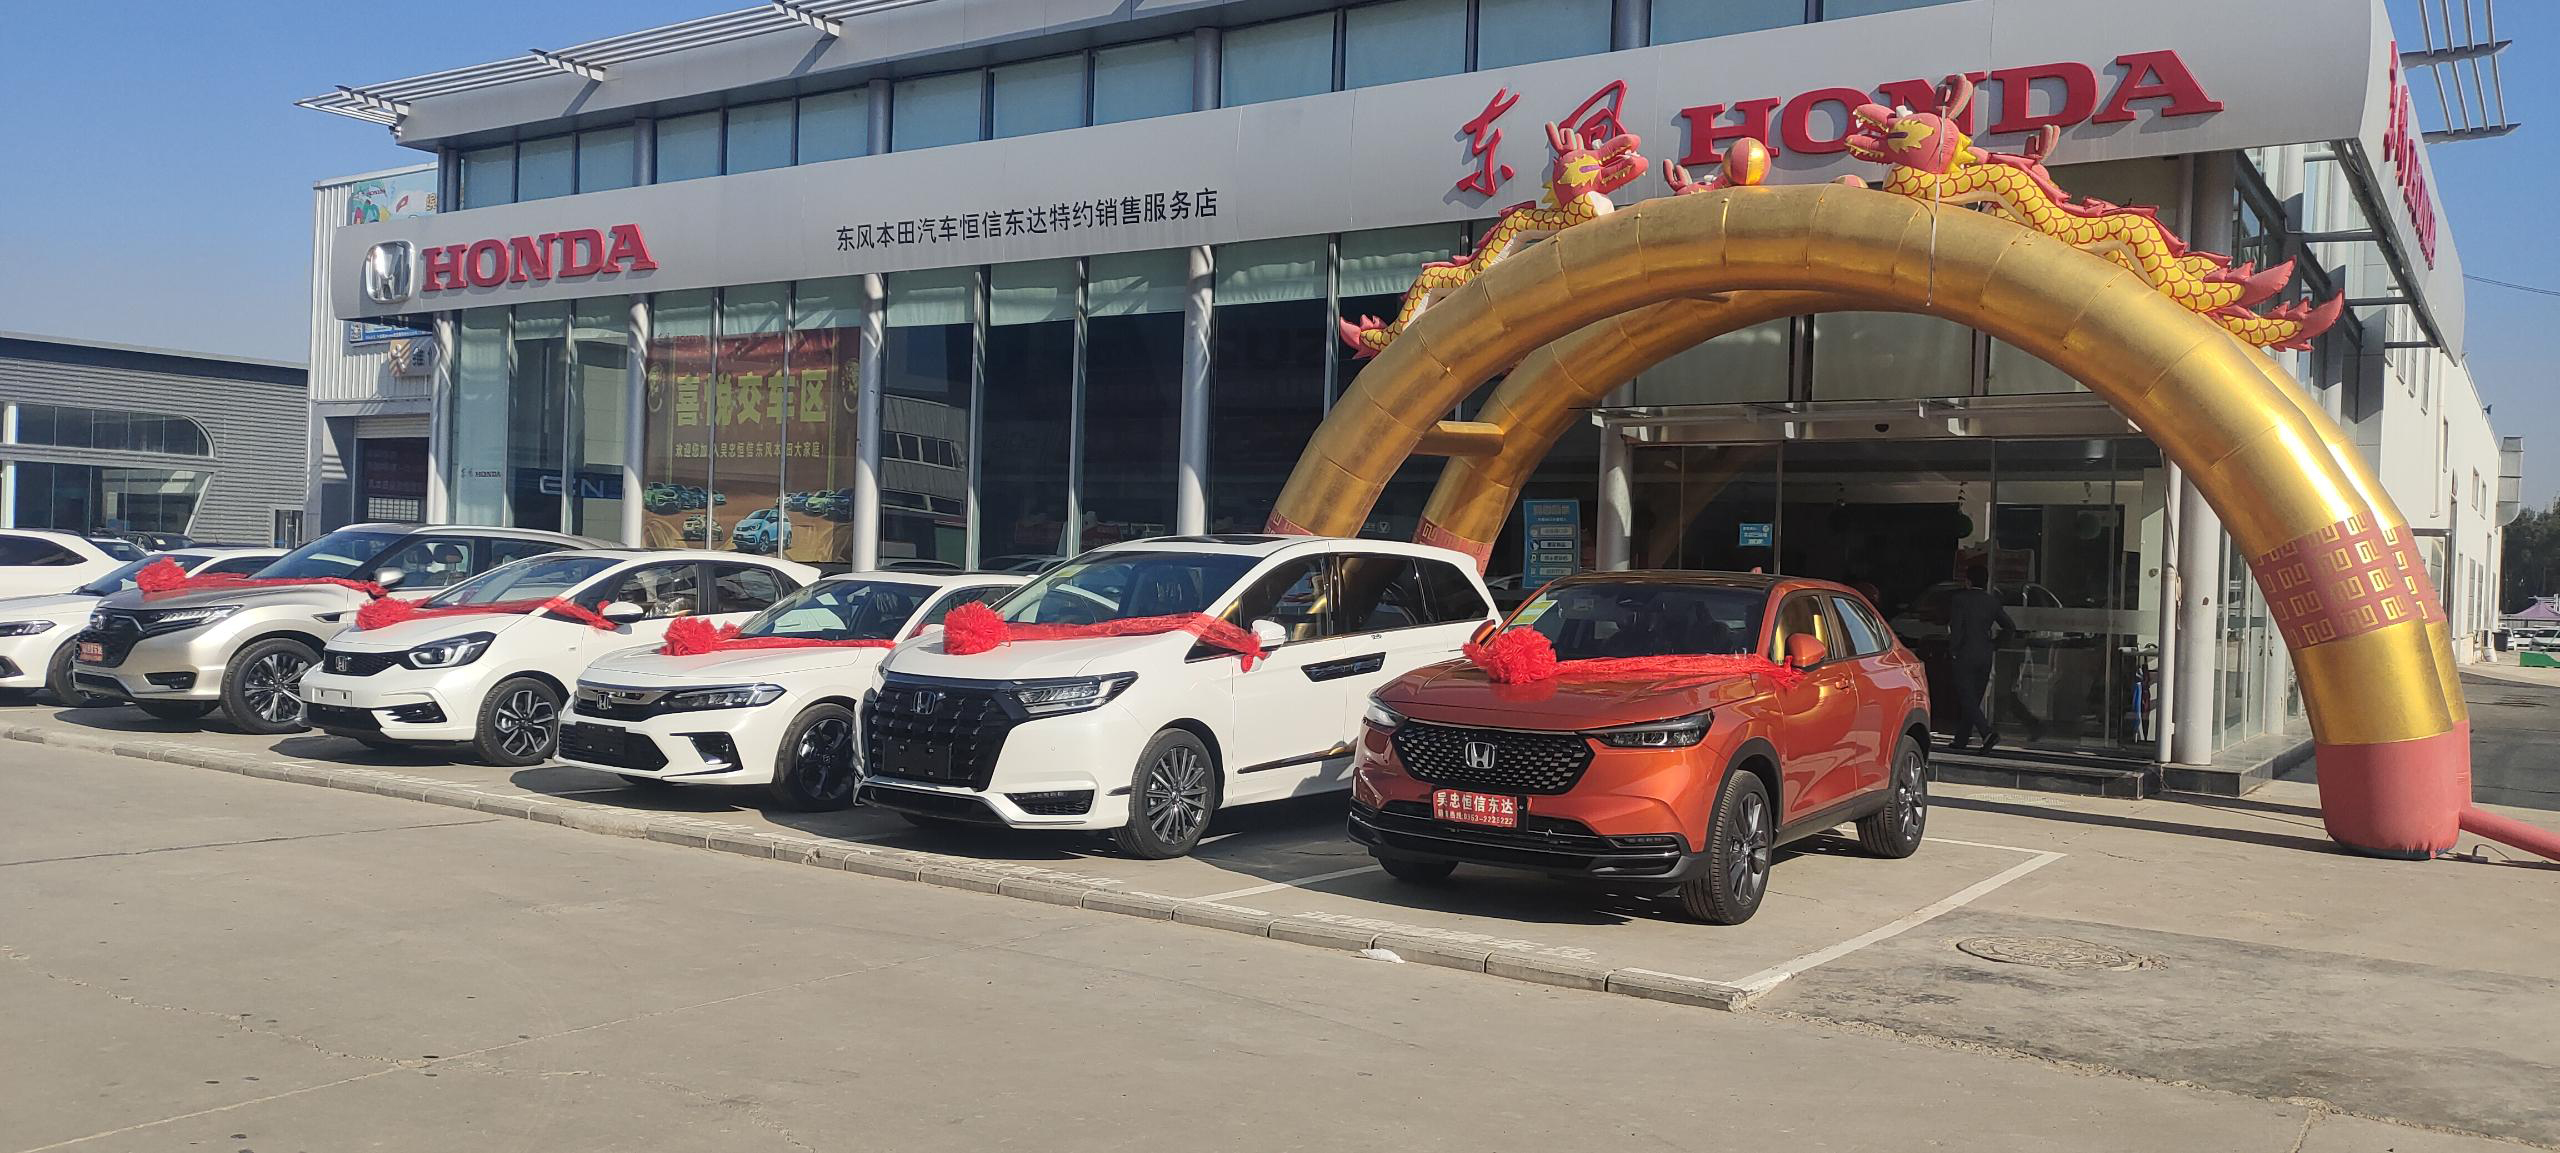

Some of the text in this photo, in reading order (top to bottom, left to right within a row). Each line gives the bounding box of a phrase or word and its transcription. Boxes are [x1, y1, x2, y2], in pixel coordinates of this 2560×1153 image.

[1681, 49, 2224, 165] HONDA
[836, 187, 1218, 252] 东风本田汽车恒信东达特约销售服务店
[421, 223, 659, 292] HONDA
[676, 369, 827, 426] 喜悦交车区
[1437, 791, 1514, 814] 吴忠恒信东达
